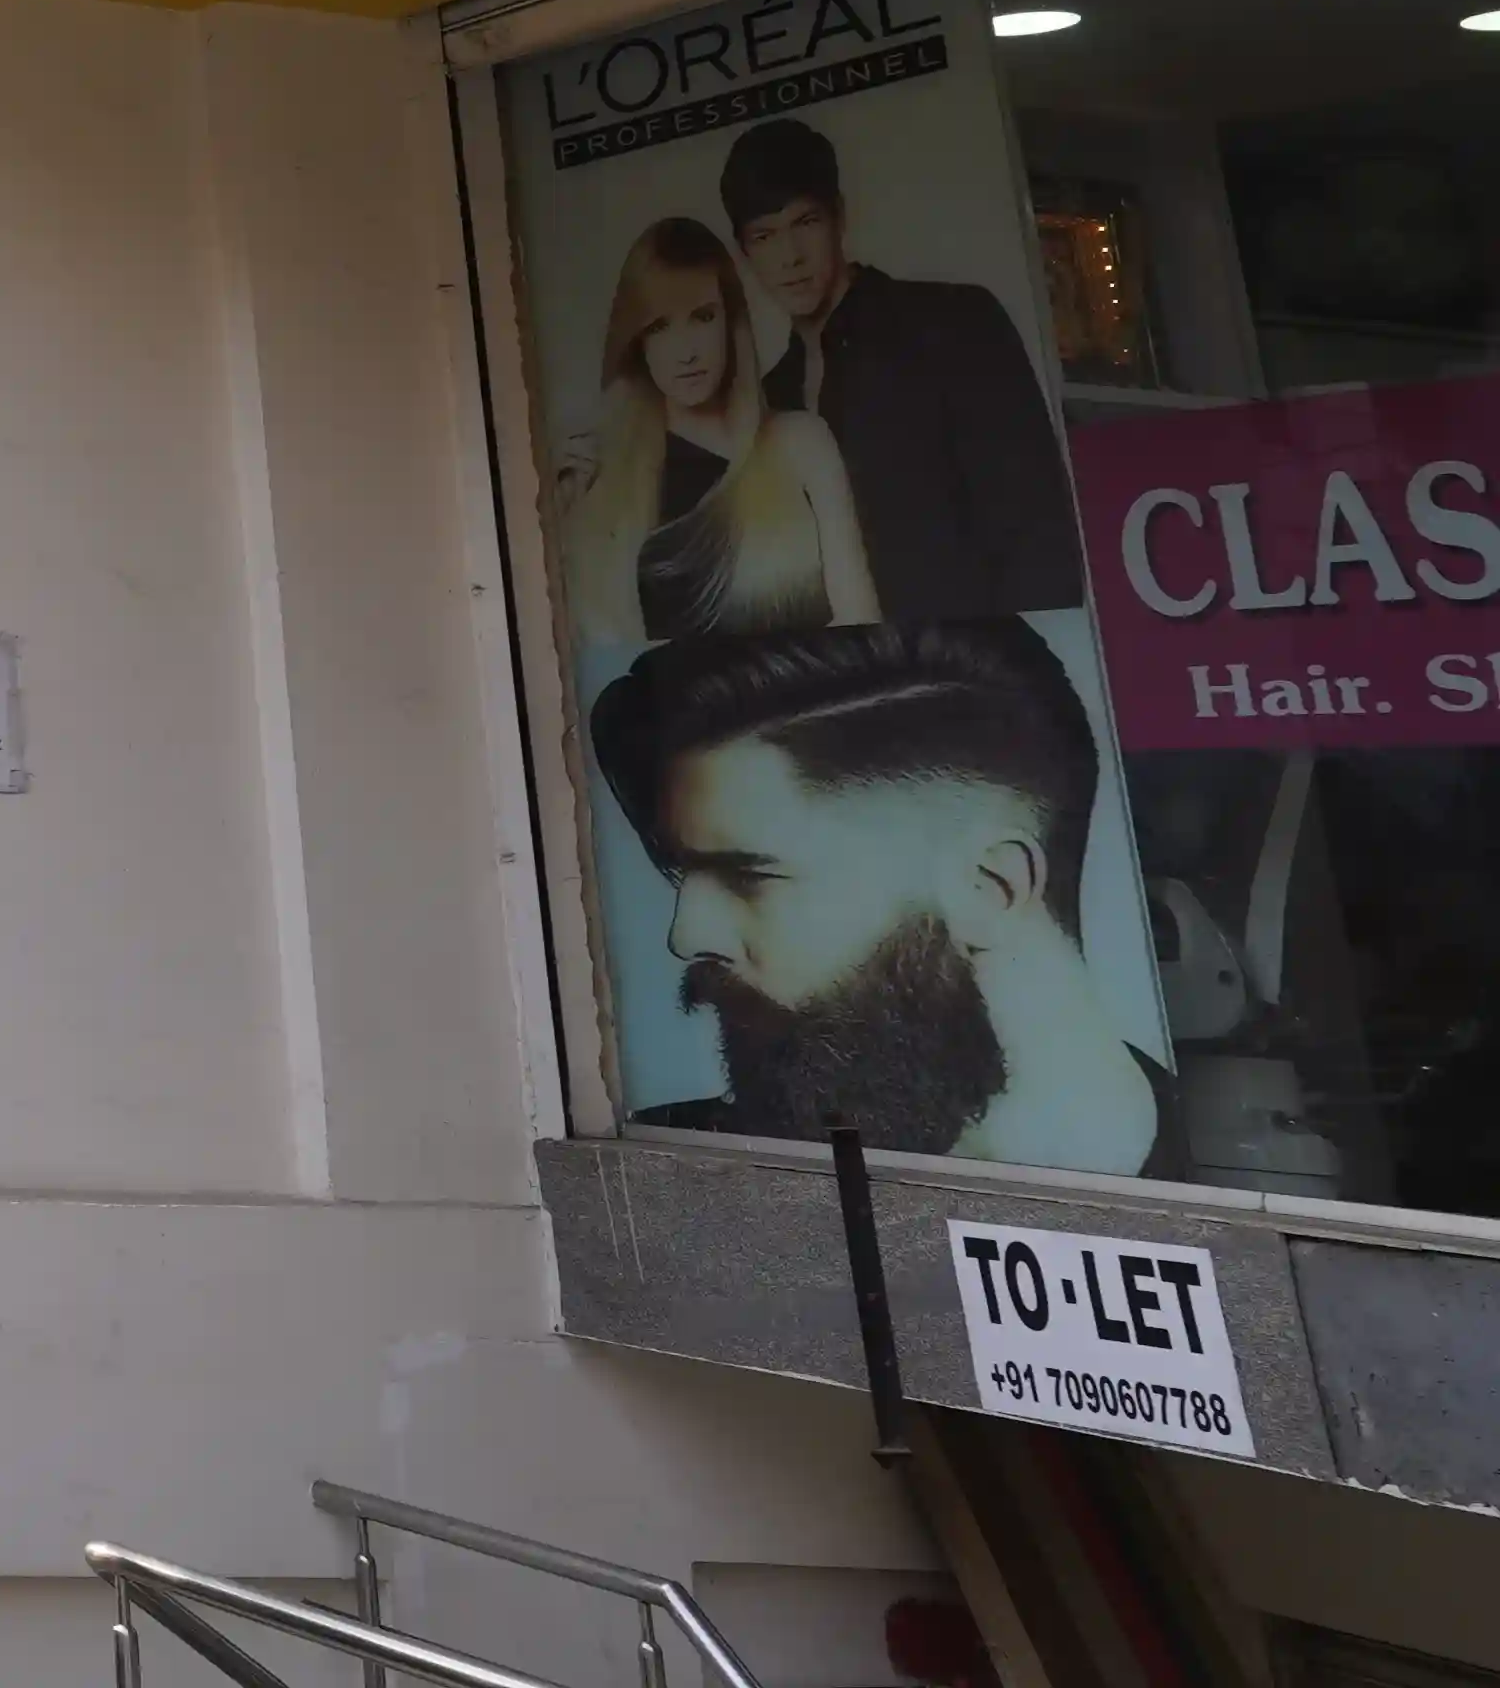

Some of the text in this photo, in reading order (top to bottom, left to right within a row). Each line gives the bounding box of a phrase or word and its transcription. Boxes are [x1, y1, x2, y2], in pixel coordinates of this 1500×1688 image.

[559, 45, 943, 165] PROFESSIONNEL
[1188, 653, 1500, 719] Hair. S
[991, 1360, 1232, 1436] +91 7090607788
